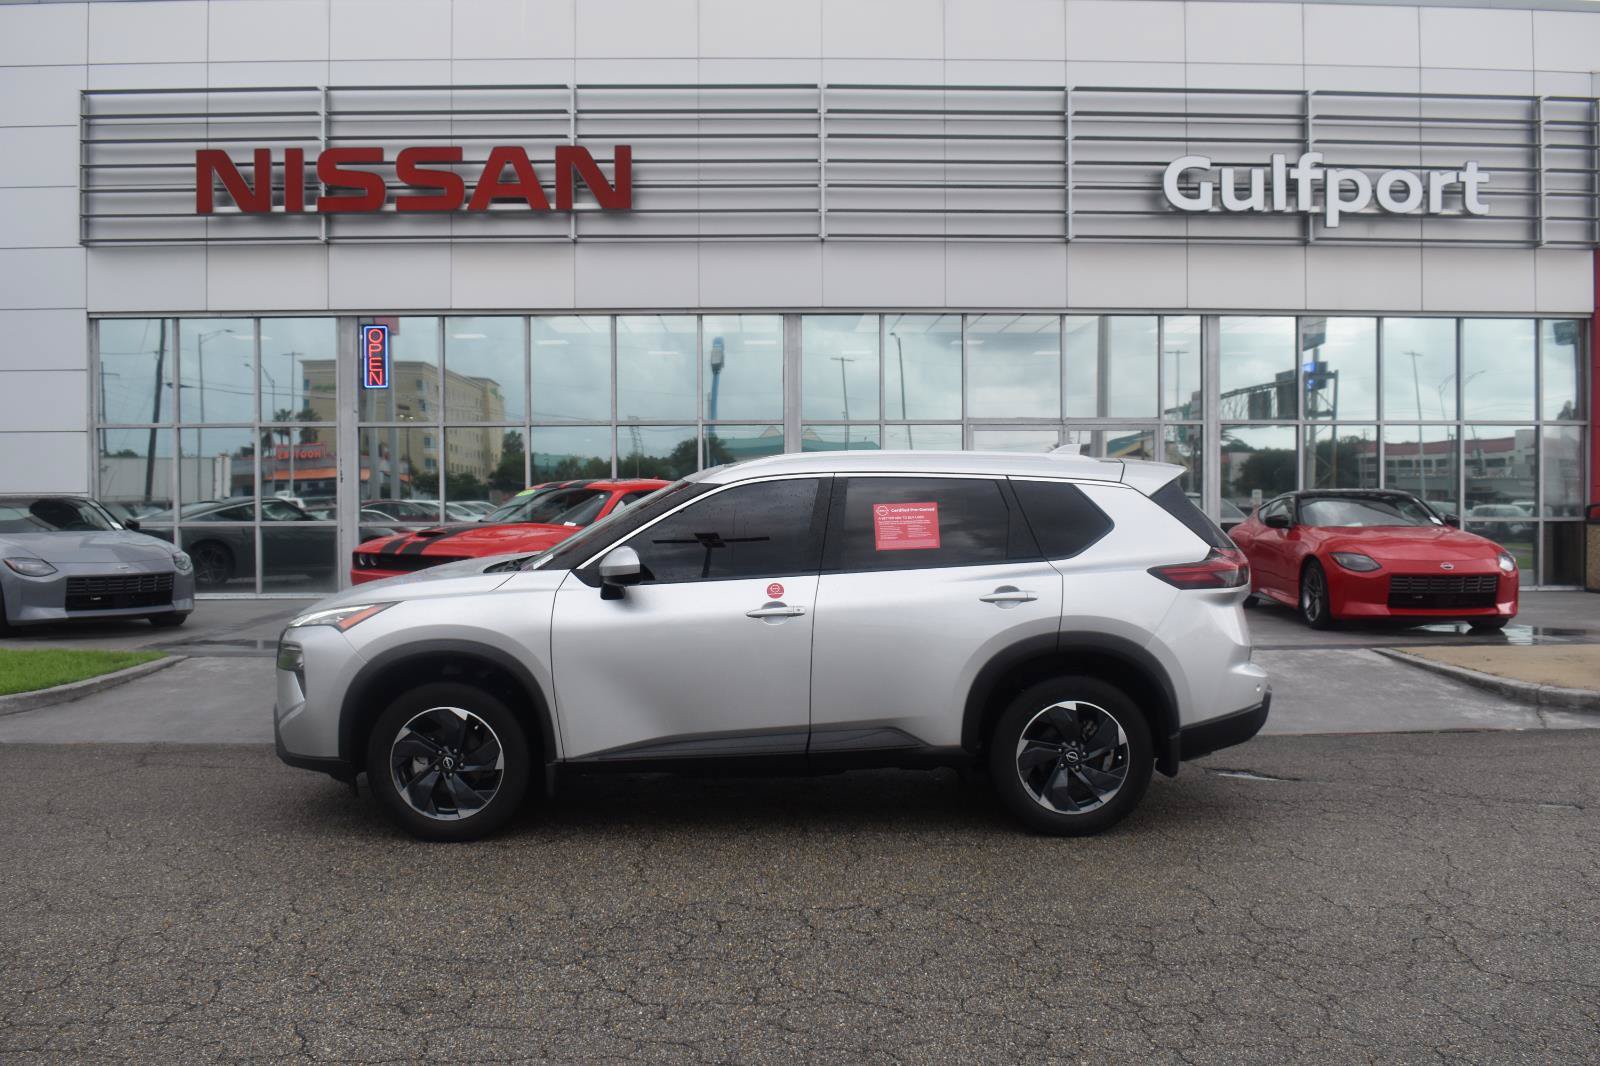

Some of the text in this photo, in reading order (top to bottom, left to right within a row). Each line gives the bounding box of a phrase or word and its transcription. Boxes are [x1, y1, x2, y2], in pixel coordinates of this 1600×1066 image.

[196, 145, 632, 214] NISSAN
[1163, 152, 1490, 228] Gulfport
[368, 328, 384, 386] OPEN
